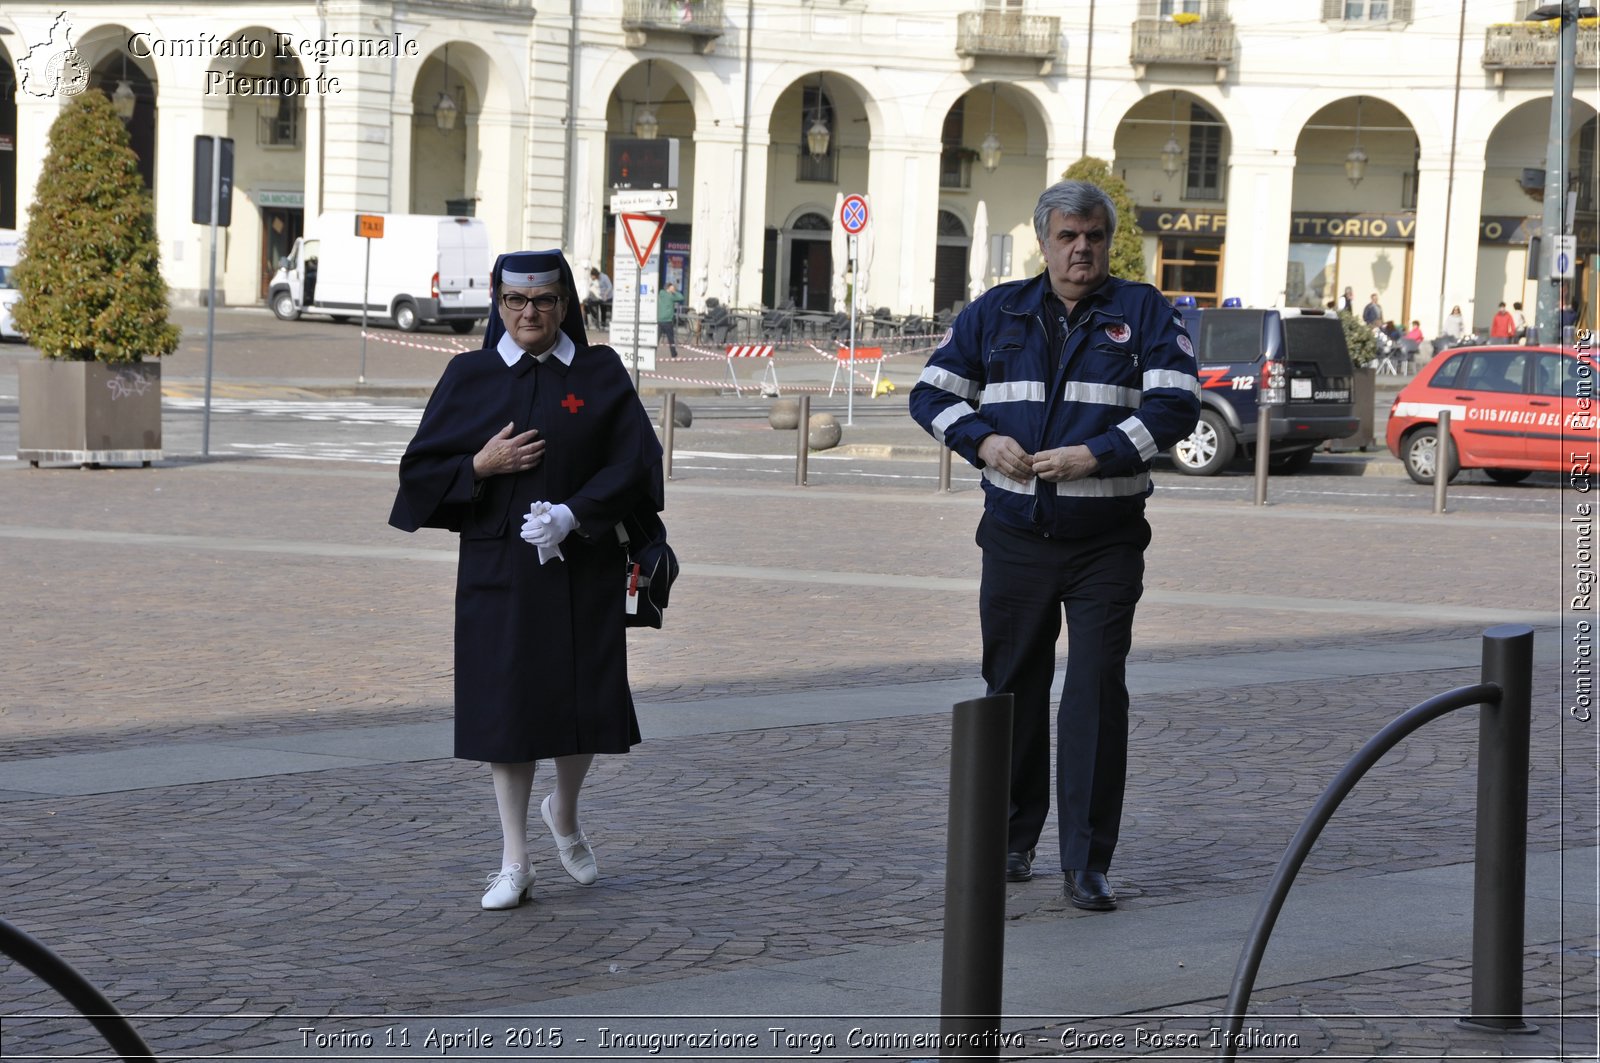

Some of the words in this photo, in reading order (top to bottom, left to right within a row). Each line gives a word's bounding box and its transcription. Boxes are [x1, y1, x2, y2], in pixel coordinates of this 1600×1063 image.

[362, 221, 382, 231] TAXI
[1158, 213, 1227, 232] CAFF
[1294, 217, 1388, 238] TTORIO
[1231, 376, 1255, 391] 112
[1480, 408, 1498, 422] 115
[1498, 409, 1537, 426] VIGILI
[1538, 411, 1561, 427] DEL
